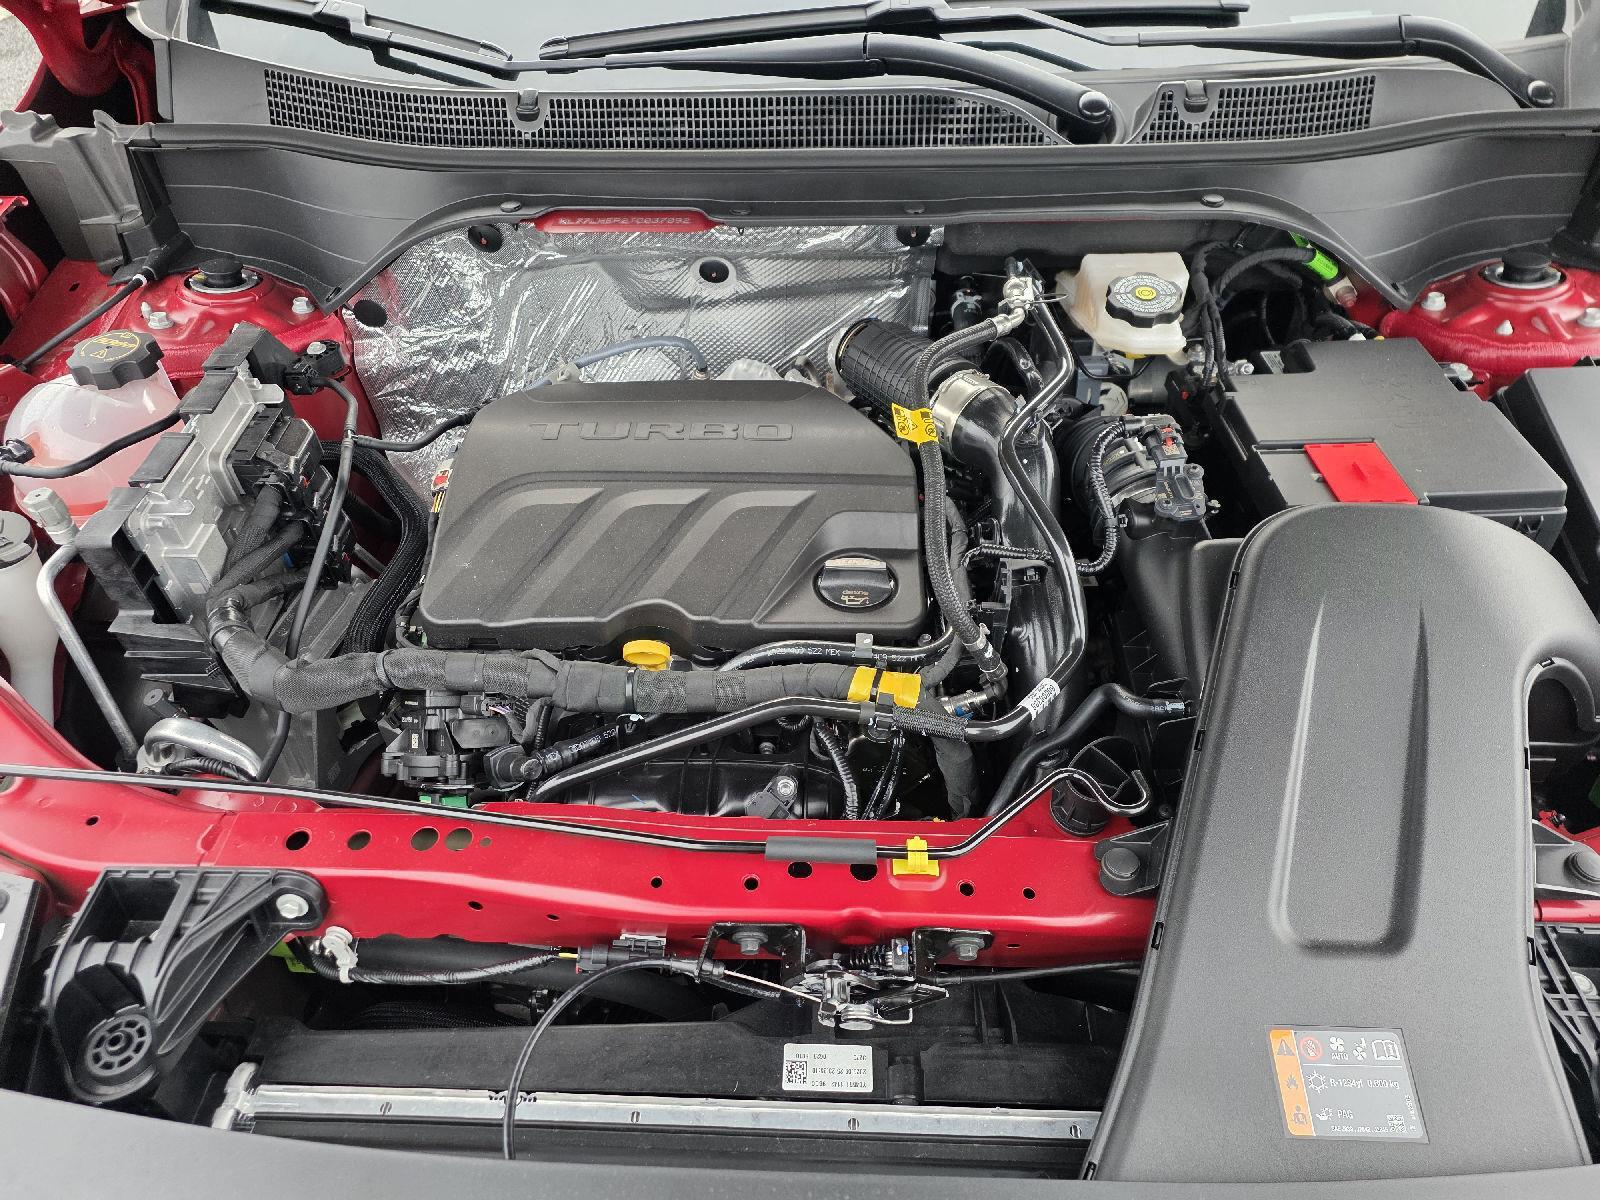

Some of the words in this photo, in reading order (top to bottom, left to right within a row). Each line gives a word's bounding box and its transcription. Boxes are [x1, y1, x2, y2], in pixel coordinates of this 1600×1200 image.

[529, 421, 793, 441] TURBO
[1331, 1052, 1349, 1061] AUTO
[1388, 1079, 1400, 1090] kg
[1337, 1109, 1354, 1120] PAG
